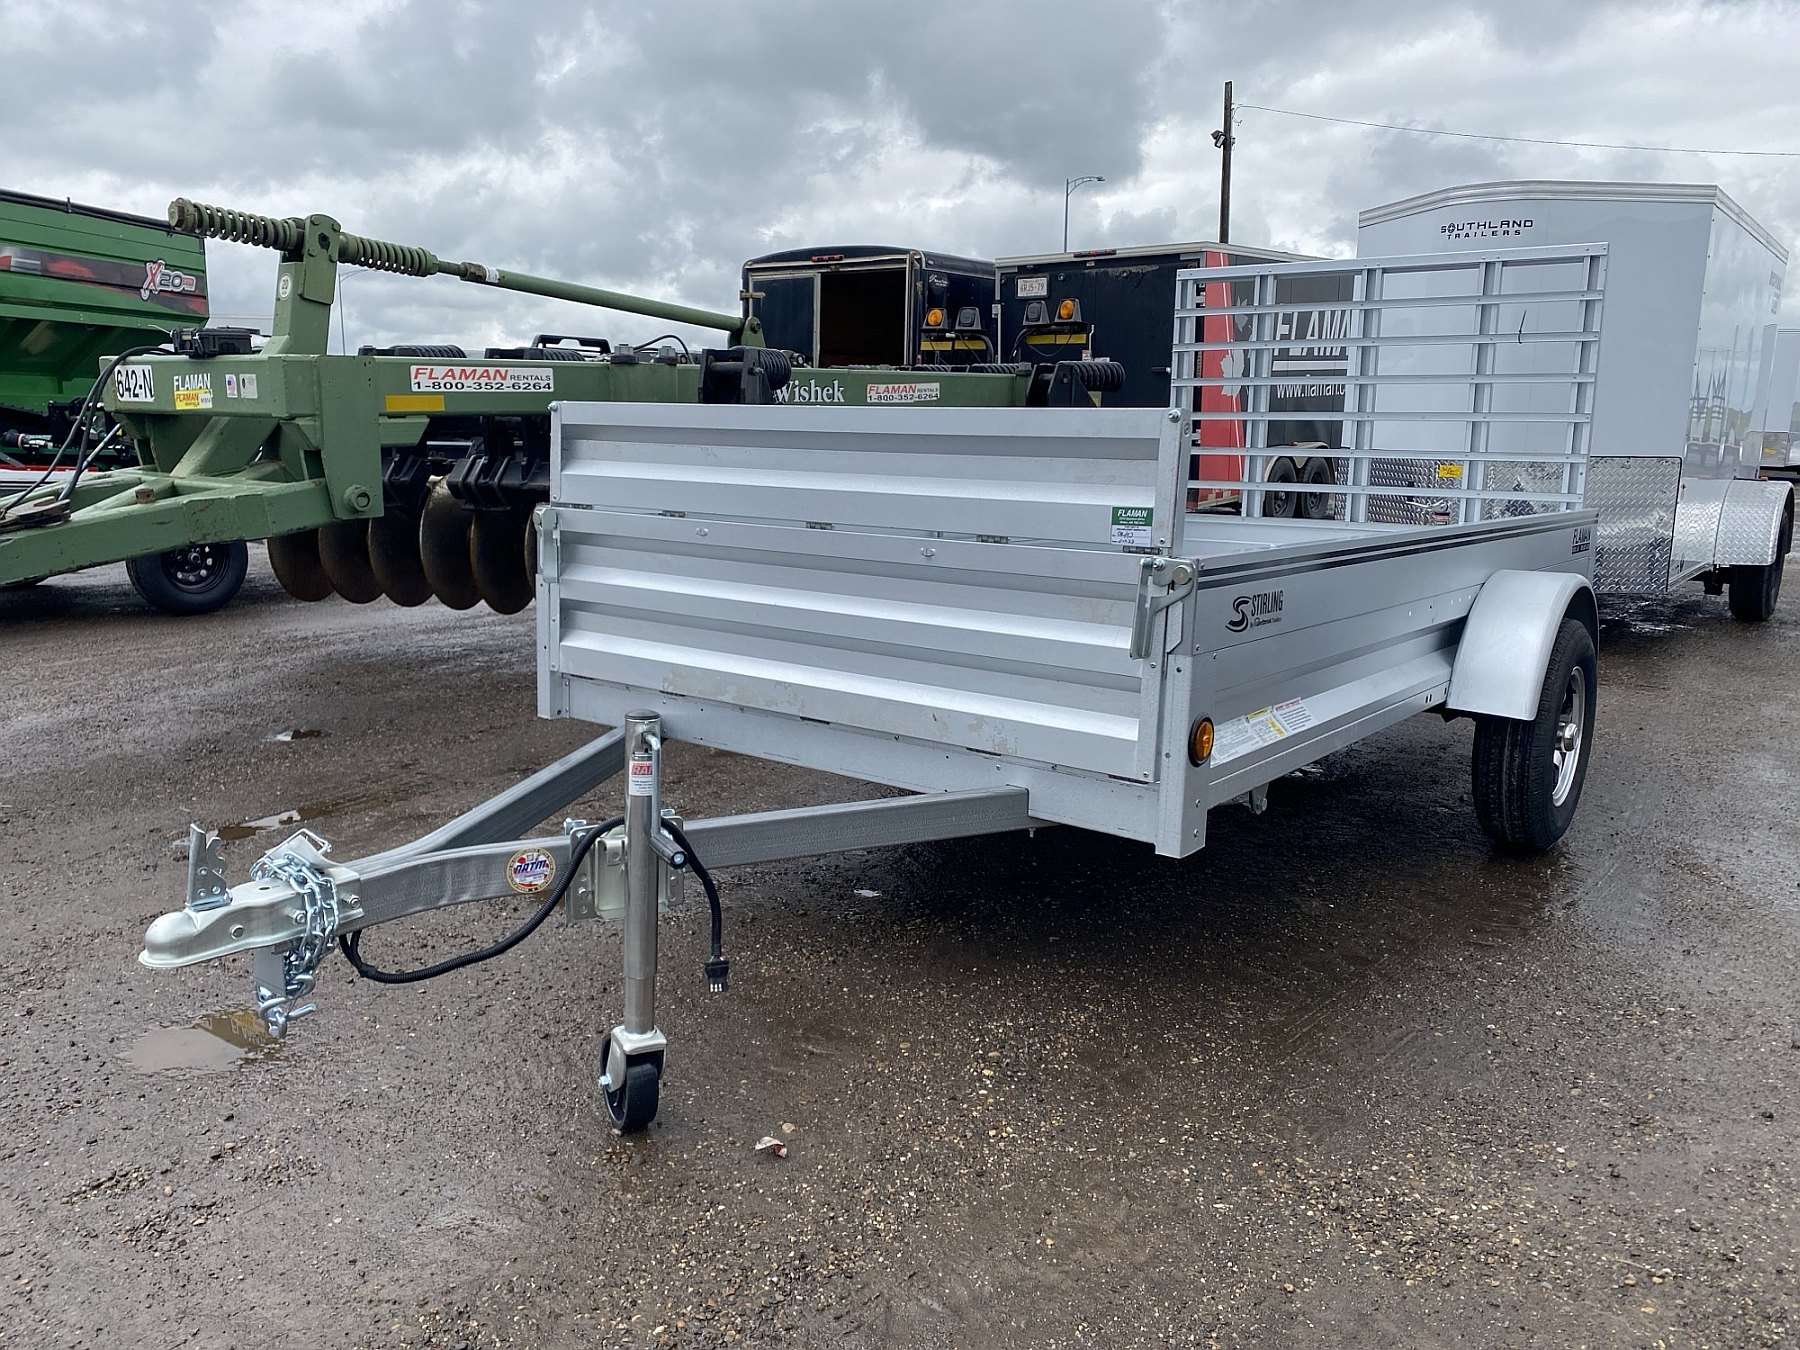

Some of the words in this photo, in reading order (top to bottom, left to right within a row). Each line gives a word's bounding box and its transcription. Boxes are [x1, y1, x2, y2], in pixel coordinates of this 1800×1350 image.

[1440, 219, 1534, 234] SOUTHLAND
[1447, 229, 1521, 240] TRAILERS
[1273, 310, 1351, 356] FLAMA
[413, 367, 509, 381] FLAMAN
[116, 368, 155, 399] 642-N
[173, 373, 211, 391] FLAMAN
[413, 381, 552, 391] 1-800-352-6264
[868, 384, 917, 395] FLAMAN
[868, 393, 939, 401] 1-800-352-6264
[1118, 509, 1148, 518] FLAMAN
[1251, 590, 1284, 617] STIRLING
